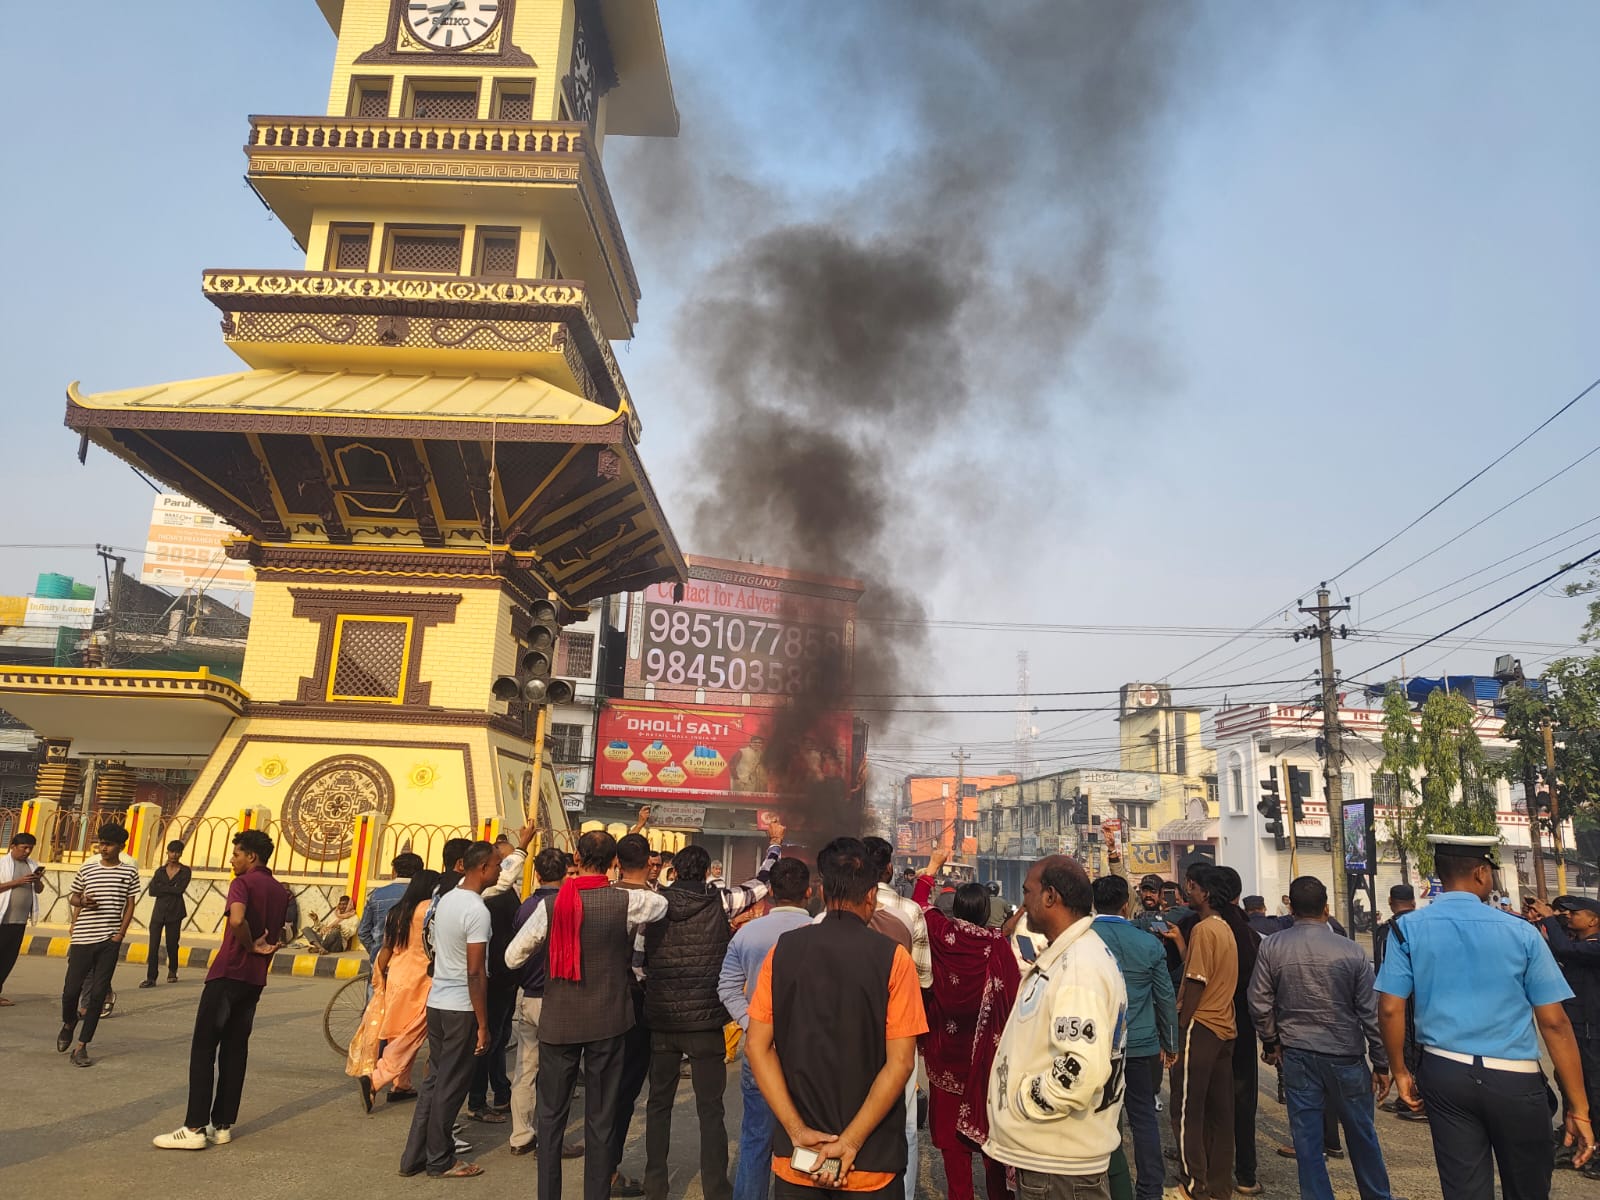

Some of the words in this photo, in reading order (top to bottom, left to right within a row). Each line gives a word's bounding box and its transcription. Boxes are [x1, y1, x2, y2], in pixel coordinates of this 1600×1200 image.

[432, 16, 470, 26] SEIKO
[163, 497, 192, 509] Parul
[725, 573, 780, 589] BIRGUNJ
[658, 583, 710, 604] Cotact
[713, 583, 733, 608] for
[30, 603, 59, 613] Infinity
[62, 604, 93, 614] Lounge
